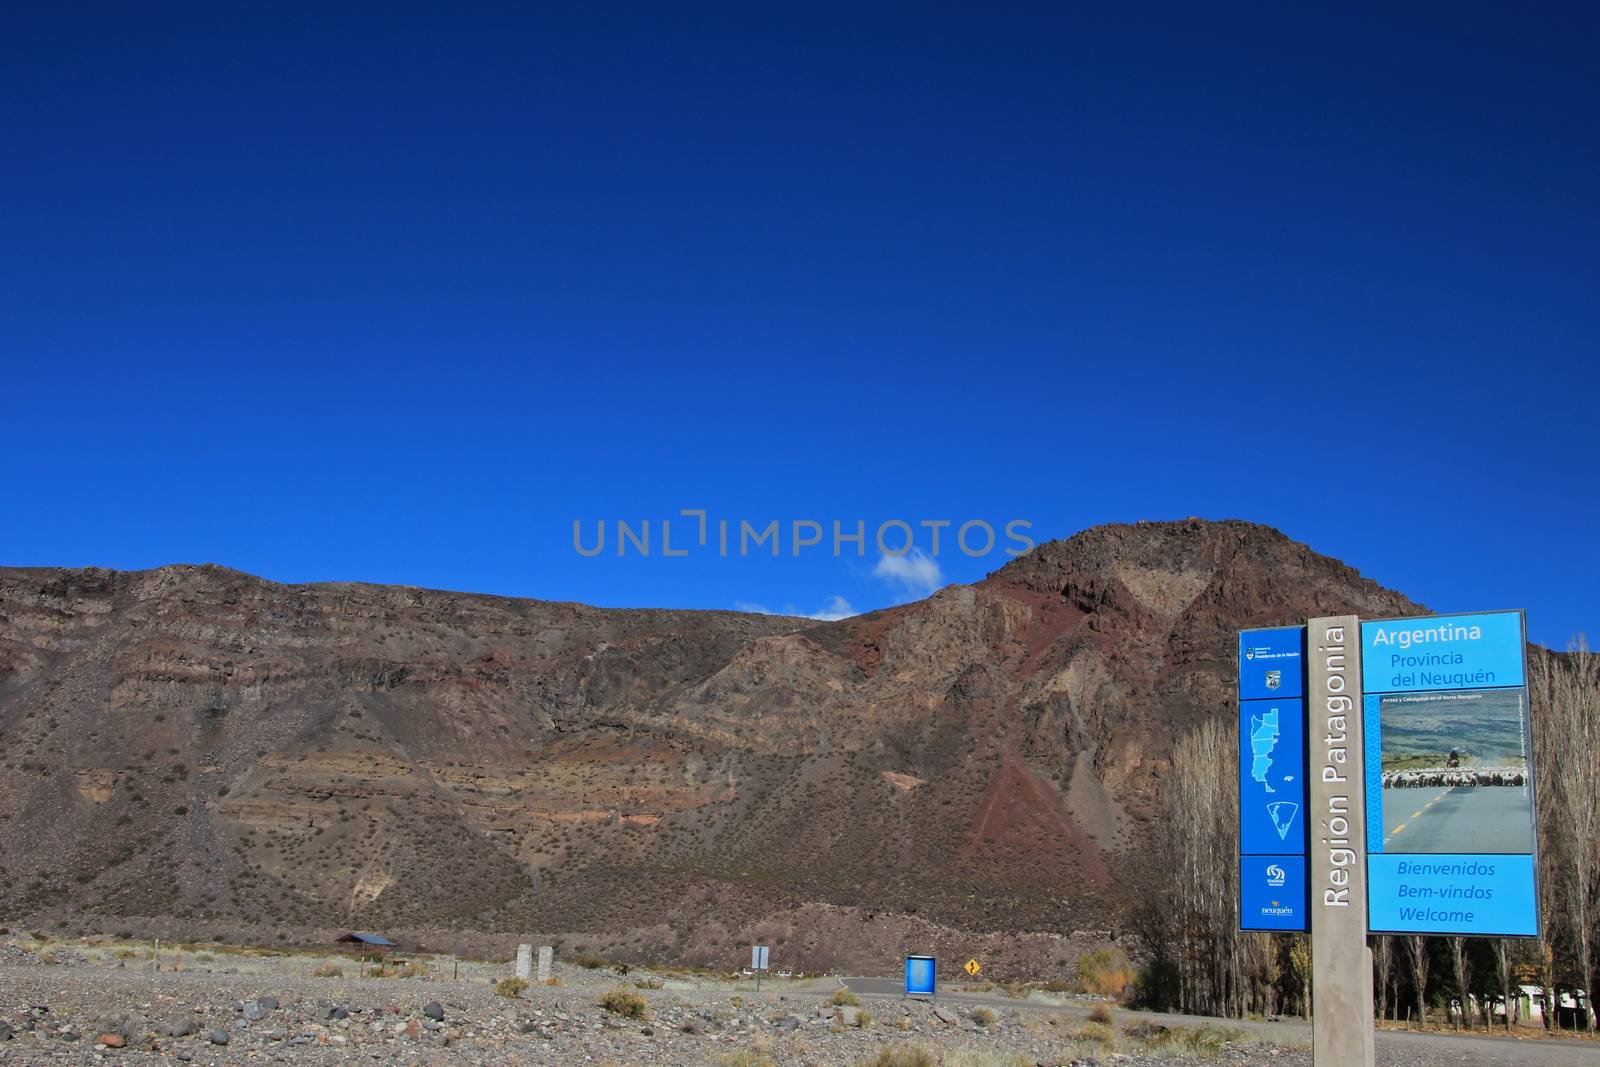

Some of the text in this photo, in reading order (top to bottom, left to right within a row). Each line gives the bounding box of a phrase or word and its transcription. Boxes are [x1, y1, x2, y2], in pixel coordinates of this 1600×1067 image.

[1373, 624, 1481, 649] Argentina
[1391, 651, 1463, 668] Provincia
[1391, 669, 1496, 688] del Neuquén
[1319, 626, 1356, 907] Región Patagonia
[1397, 861, 1496, 876] Bienvenidos
[1398, 884, 1493, 899] Bem-vindos
[1262, 906, 1292, 916] neuquén
[1399, 907, 1475, 923] Welcome
